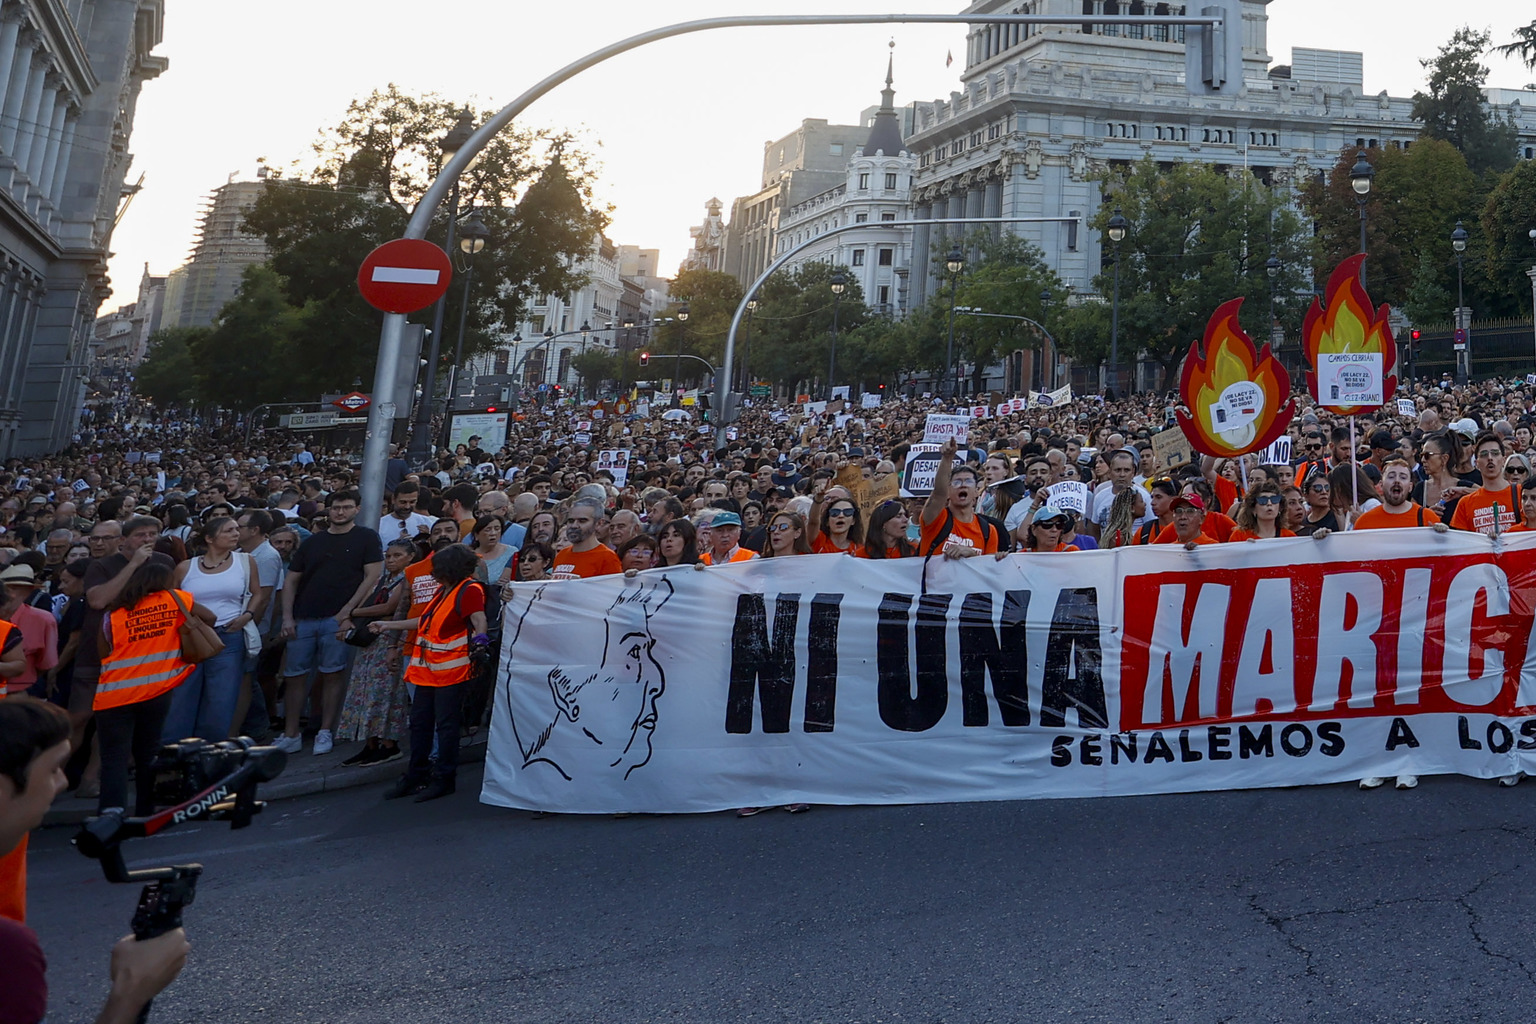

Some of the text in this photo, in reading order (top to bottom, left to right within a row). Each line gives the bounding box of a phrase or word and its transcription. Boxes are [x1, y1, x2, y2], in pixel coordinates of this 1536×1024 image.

[1328, 354, 1351, 362] CAMPOS
[1273, 441, 1289, 463] NO
[1475, 518, 1482, 526] DE
[127, 603, 167, 619] SINDICATO
[128, 635, 138, 643] DE
[725, 593, 844, 734] NI
[877, 587, 1109, 733] UNA
[1050, 721, 1346, 767] SEÑALEMOS
[1385, 717, 1420, 752] A
[173, 786, 227, 823] RONIN
